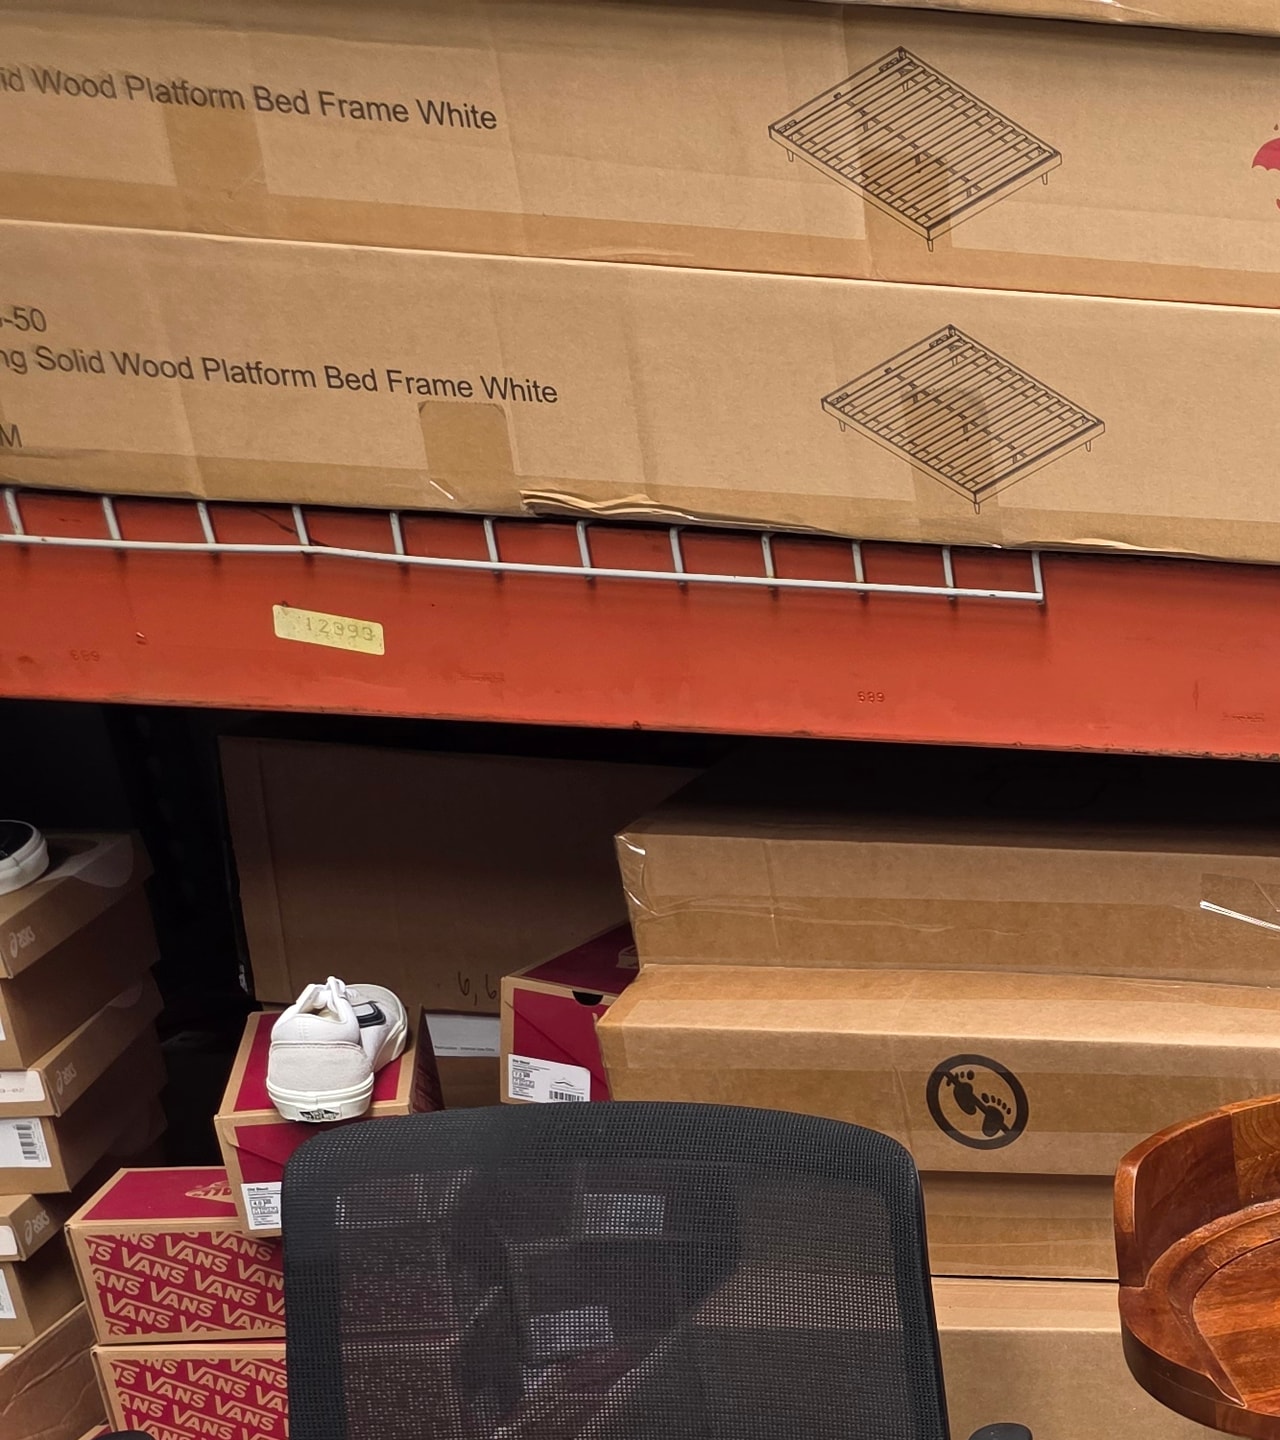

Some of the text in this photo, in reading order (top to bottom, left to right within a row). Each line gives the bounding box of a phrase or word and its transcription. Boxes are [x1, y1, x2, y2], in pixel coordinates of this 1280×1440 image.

[31, 68, 118, 99] Wood
[126, 75, 245, 110] Platform
[254, 85, 310, 115] Bed
[318, 91, 409, 123] Frame
[415, 99, 497, 129] White
[0, 308, 47, 333] -50
[34, 345, 106, 375] Solid
[110, 351, 194, 381] Wood
[203, 357, 316, 389] Platform
[324, 365, 377, 393] Bed
[386, 370, 474, 398] Frame
[480, 375, 558, 403] White
[121, 1246, 189, 1284] VANS
[165, 1235, 232, 1273] VANS
[210, 1231, 276, 1262] VANS
[150, 1281, 217, 1318] VANS
[194, 1270, 261, 1307] VANS
[106, 1292, 174, 1329] VANS
[145, 1371, 210, 1409] VANS
[186, 1361, 250, 1399] VANS
[172, 1404, 237, 1440] VANS
[215, 1395, 278, 1431] VANS
